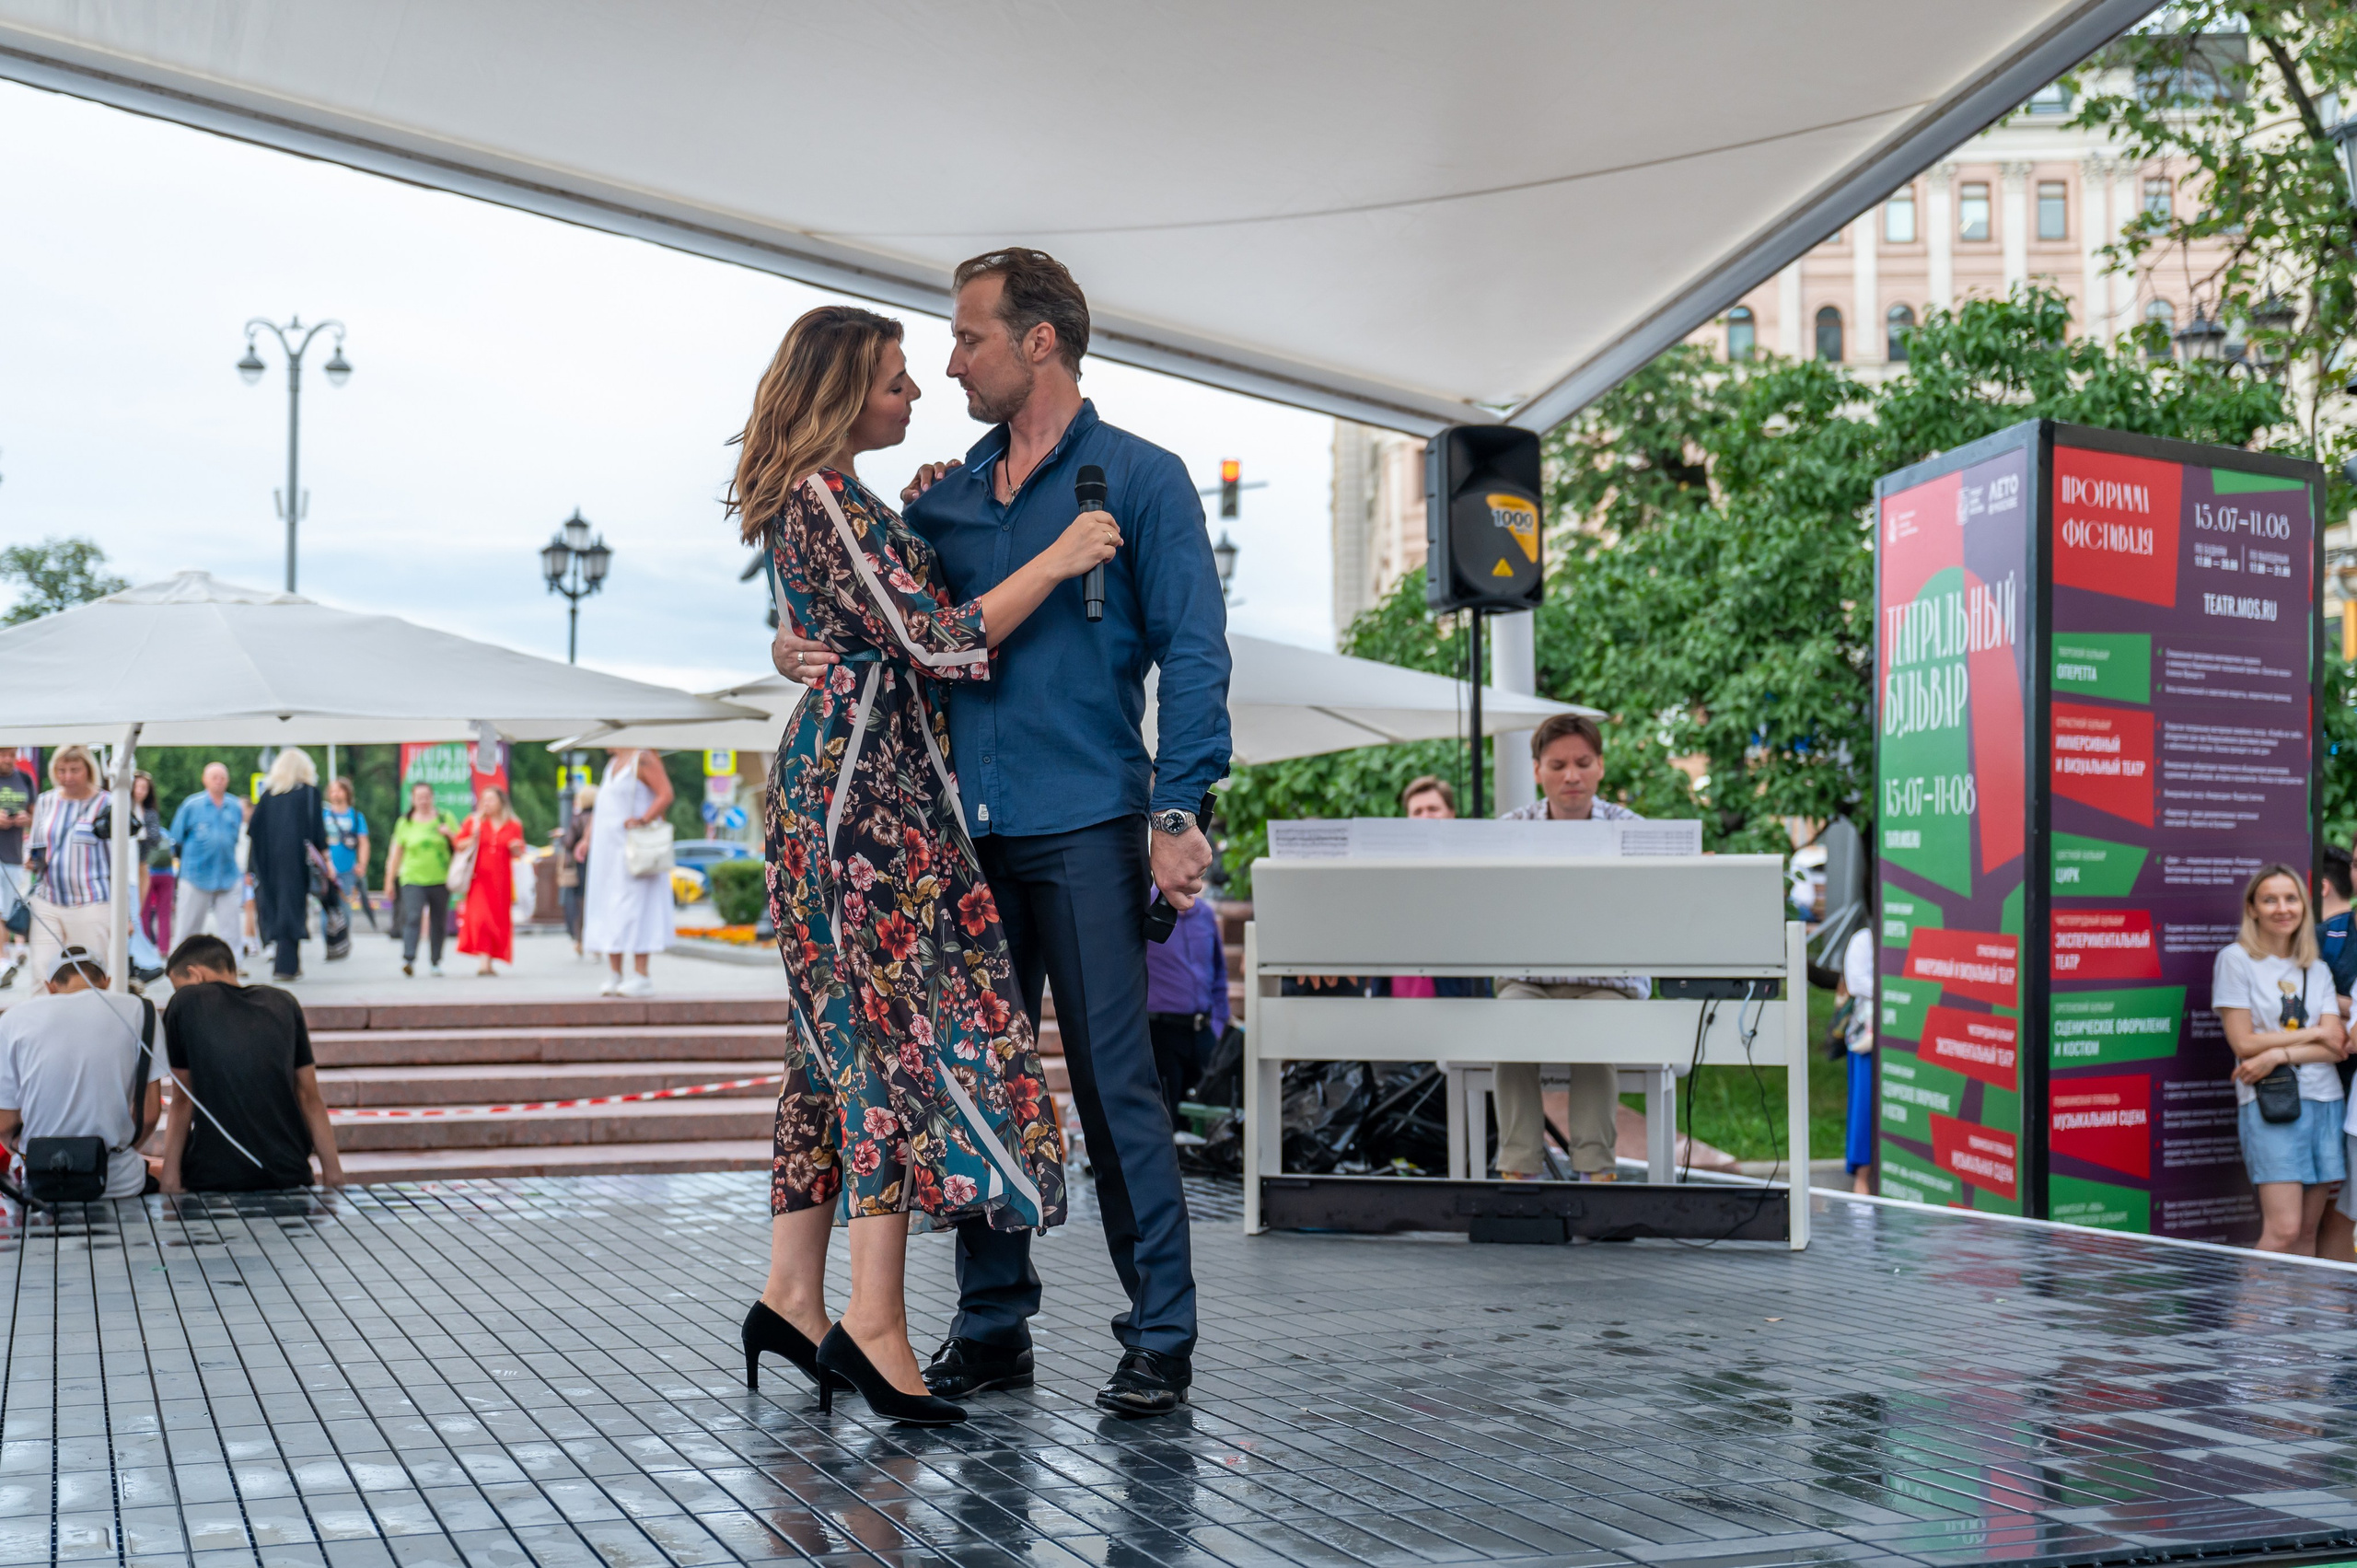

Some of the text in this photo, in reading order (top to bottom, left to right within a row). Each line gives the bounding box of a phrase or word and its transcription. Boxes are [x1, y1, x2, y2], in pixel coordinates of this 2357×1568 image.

[1492, 509, 1534, 528] 1000
[2203, 592, 2278, 621] TEATR.MOS.RU
[1886, 569, 2016, 668] ТЕАТРАЛЬНЫЙ
[2056, 663, 2097, 682] ОПЕРЕТТА
[1886, 662, 1968, 738] БУЛЬВАР
[2122, 760, 2146, 777] ТЕАТР
[2055, 866, 2080, 884] ЦИРК
[2055, 953, 2080, 970] ТЕАТР
[2119, 1109, 2146, 1127] СЦЕНА
